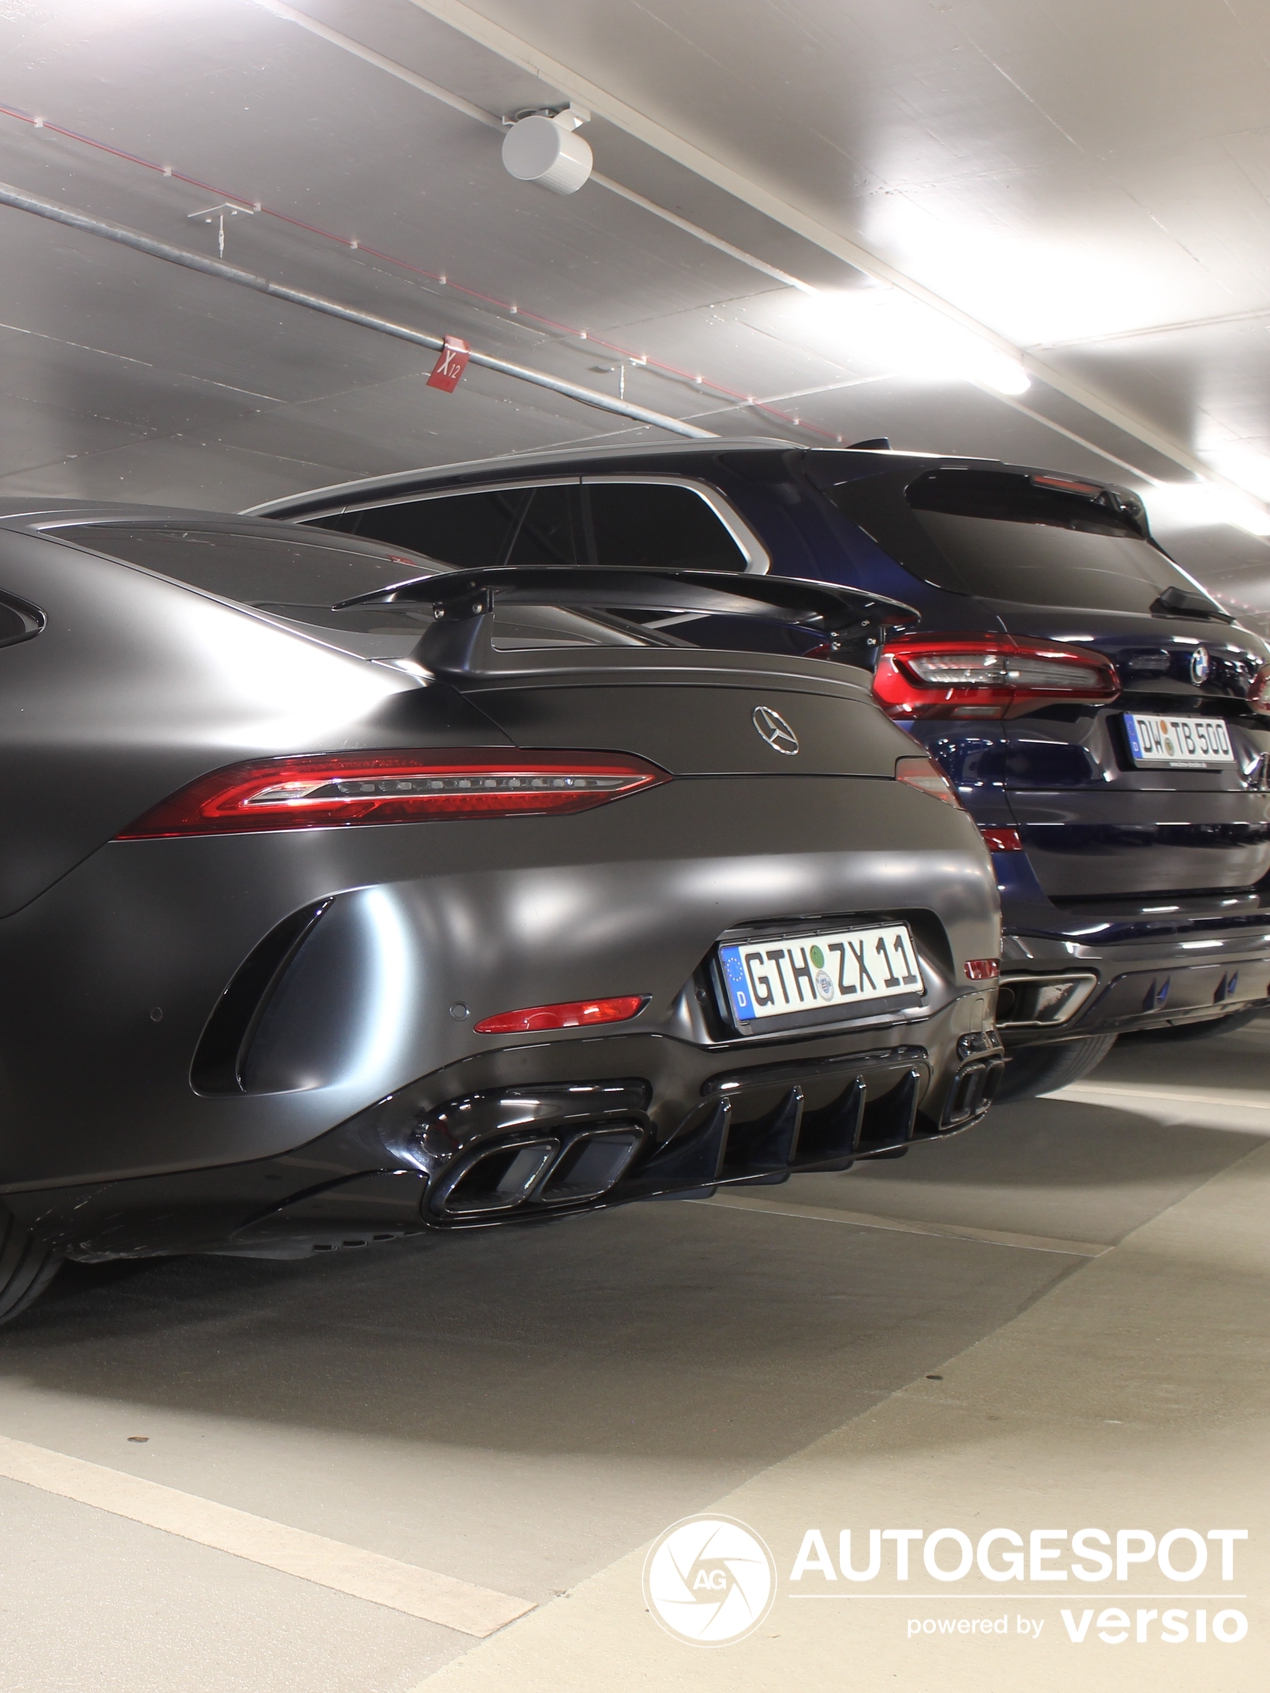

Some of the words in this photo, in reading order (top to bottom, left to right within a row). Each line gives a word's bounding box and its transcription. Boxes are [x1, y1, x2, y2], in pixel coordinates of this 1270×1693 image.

[1136, 720, 1164, 754] DW
[1170, 722, 1196, 755] TB
[1195, 723, 1230, 756] 500
[744, 946, 817, 1007] GTH
[828, 939, 877, 996] ZX
[875, 934, 918, 988] 11
